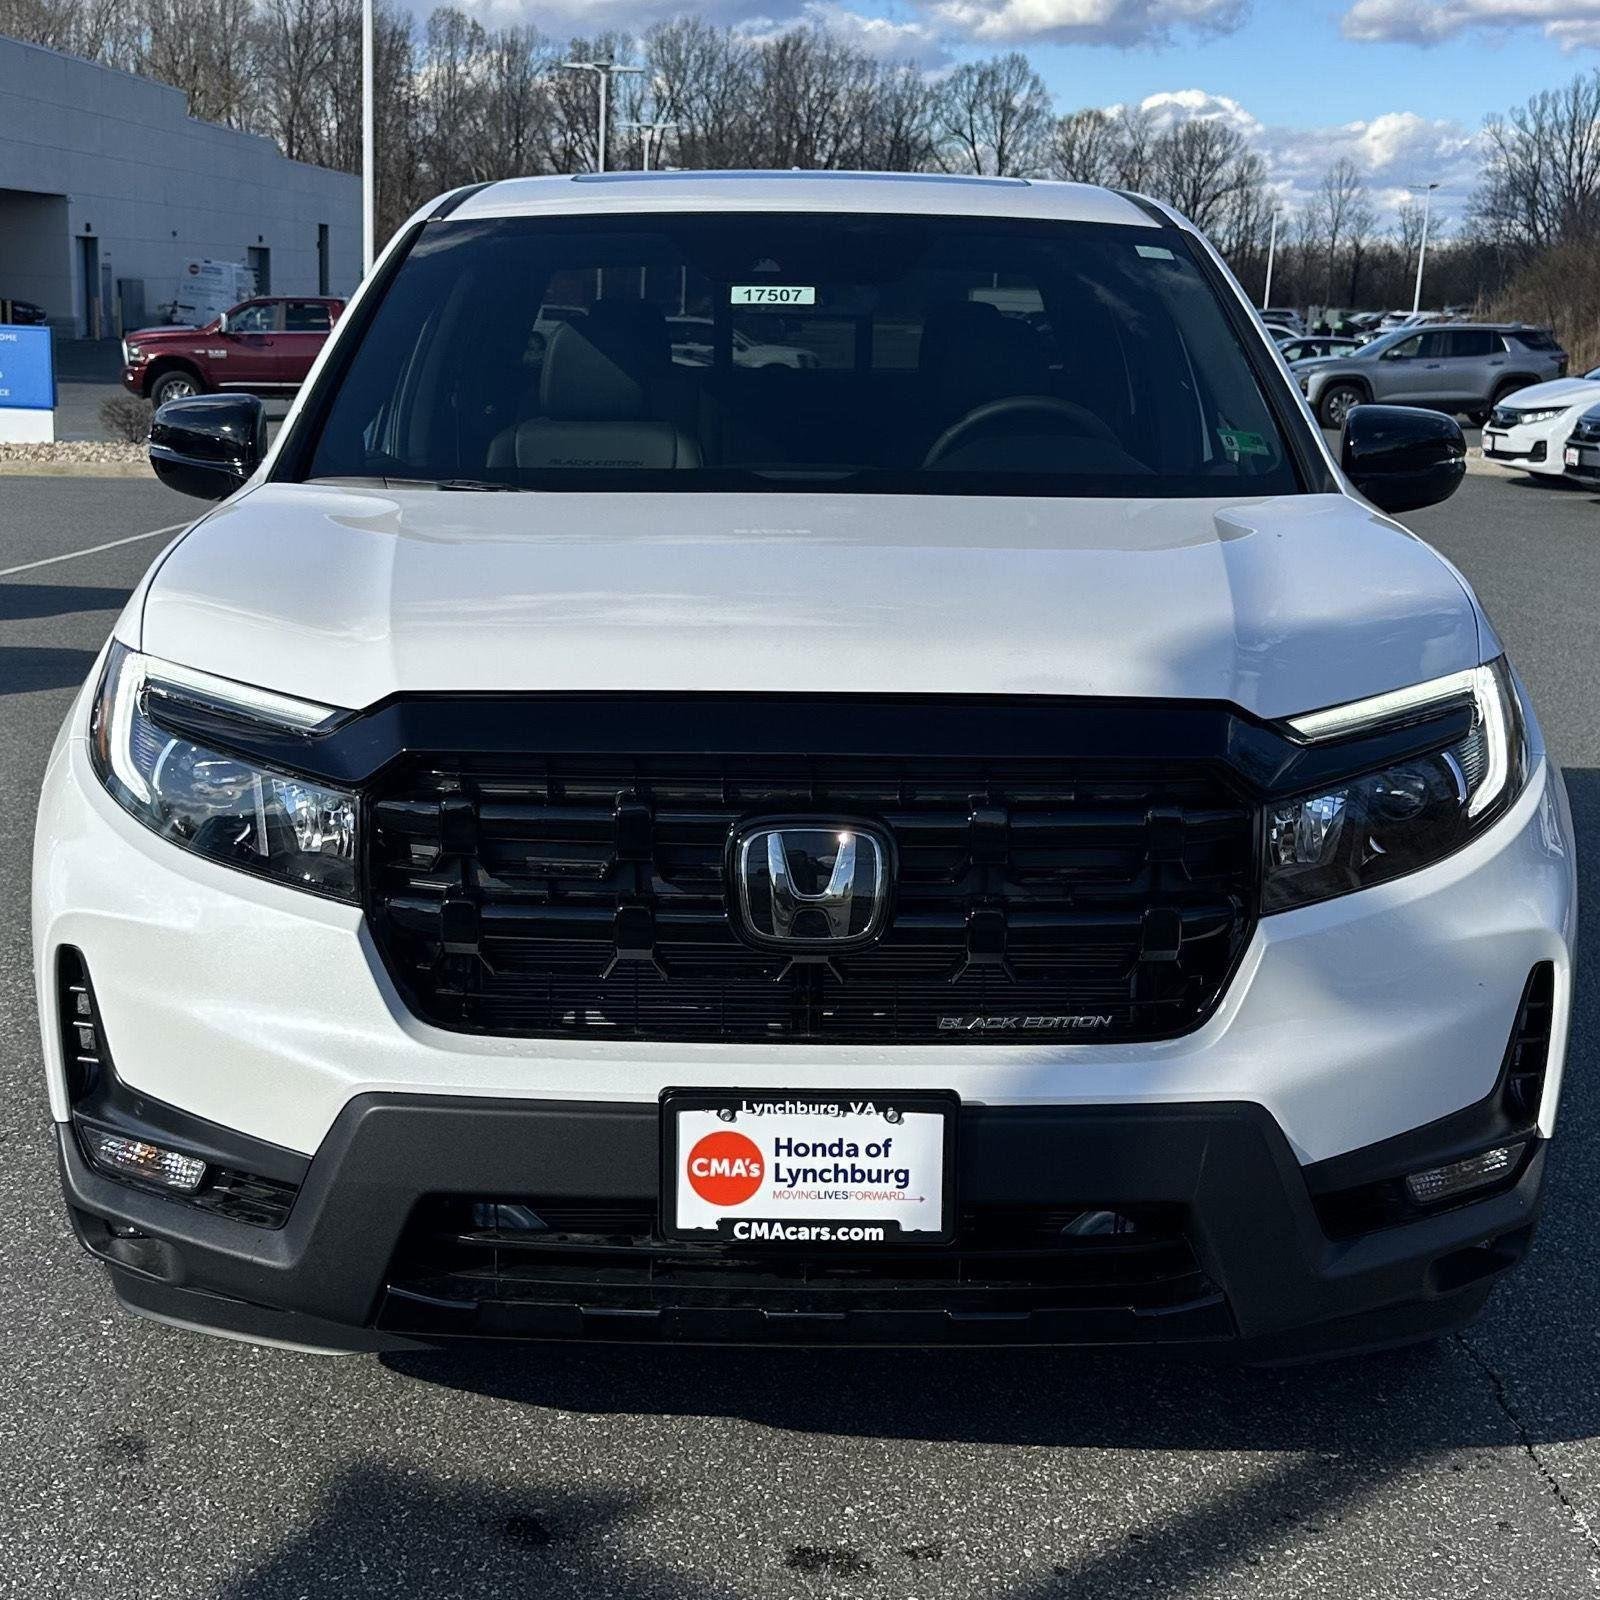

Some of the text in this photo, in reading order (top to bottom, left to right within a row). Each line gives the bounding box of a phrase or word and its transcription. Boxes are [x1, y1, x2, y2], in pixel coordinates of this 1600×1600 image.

[743, 289, 803, 302] 17507
[938, 1016, 1112, 1030] BLACK EDITION
[741, 1101, 877, 1117] Lynchburg, VA
[774, 1137, 893, 1158] Honda of
[691, 1157, 761, 1178] CMA's
[774, 1163, 910, 1188] Lynchburg
[733, 1221, 884, 1241] CMAcars.com
